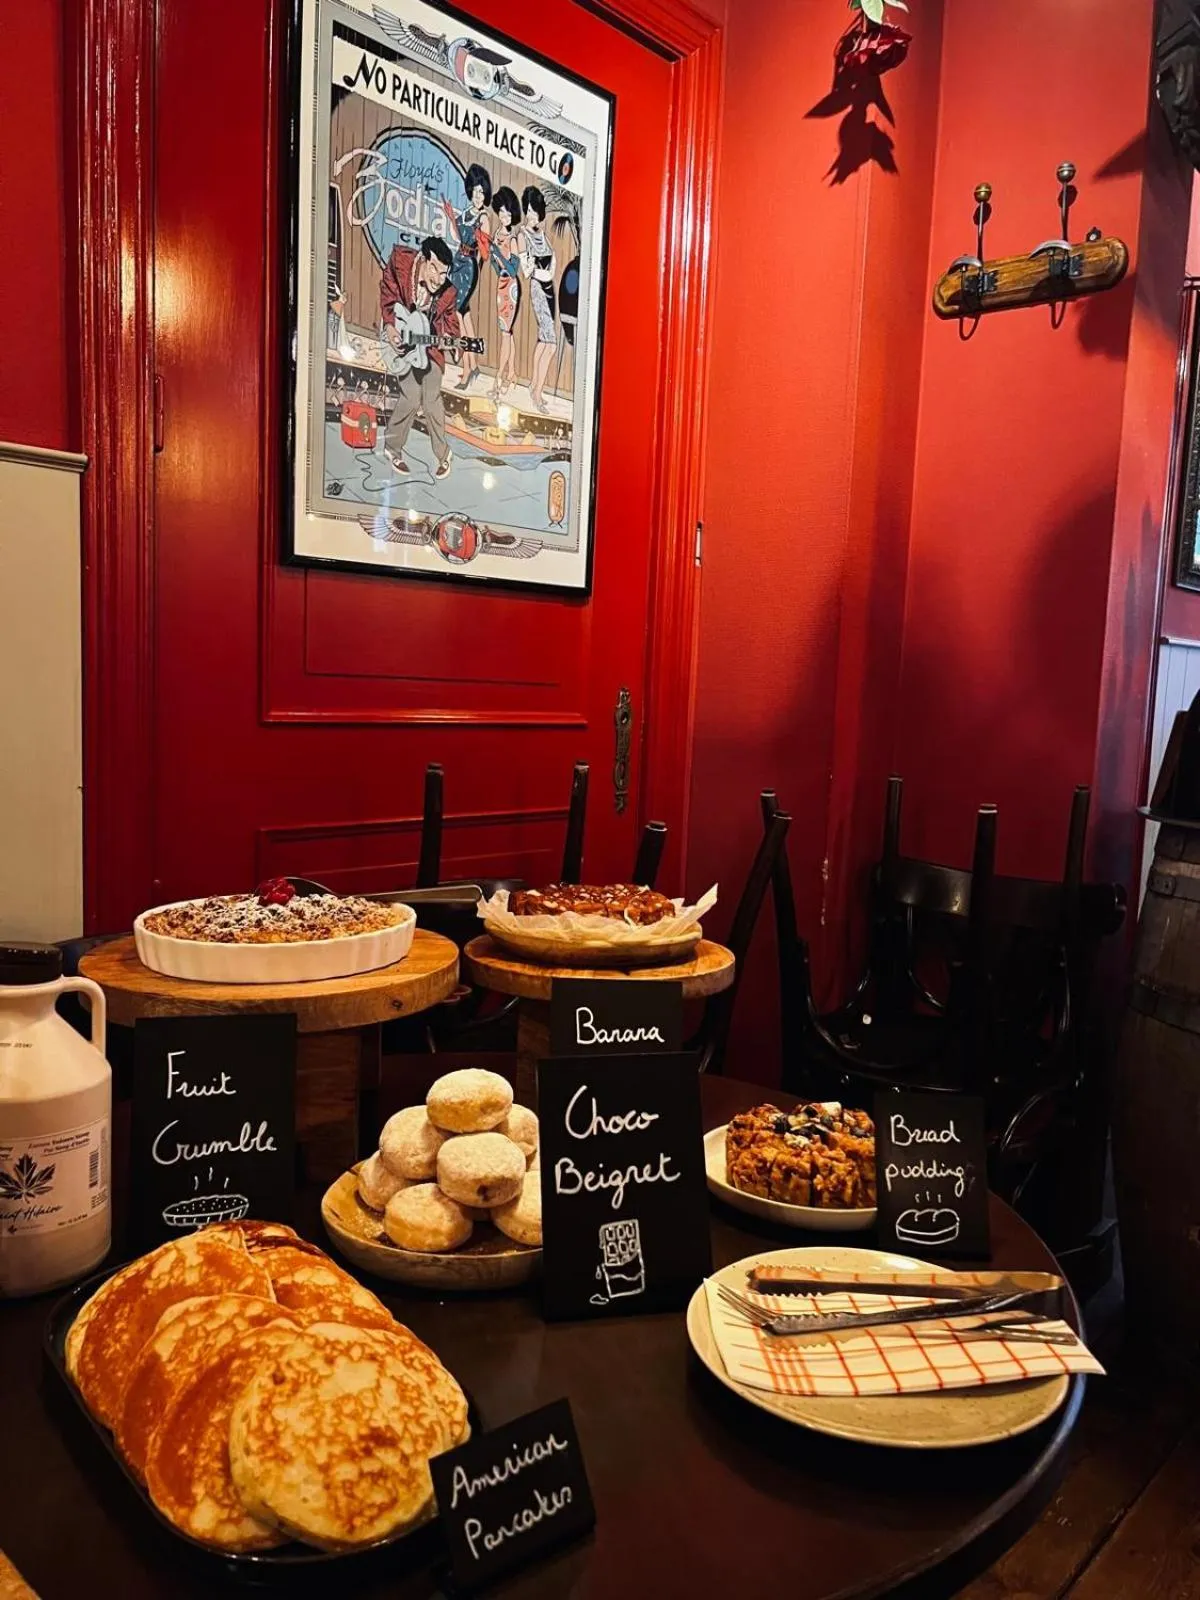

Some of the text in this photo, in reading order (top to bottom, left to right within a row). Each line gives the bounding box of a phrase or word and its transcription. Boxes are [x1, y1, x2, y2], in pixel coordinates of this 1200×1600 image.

[343, 53, 574, 185] NO PARTICULAR PLACE TO GO
[334, 149, 449, 239] Zodia
[390, 159, 445, 183] Floyd's
[576, 1007, 665, 1044] Banana
[167, 1051, 236, 1098] Fruit
[566, 1085, 659, 1139] Choco
[890, 1114, 960, 1147] Bread
[153, 1120, 276, 1164] Crumble
[555, 1153, 681, 1209] Beignet
[885, 1160, 965, 1197] pudding
[451, 1433, 568, 1509] American
[465, 1486, 572, 1559] Pancakes
